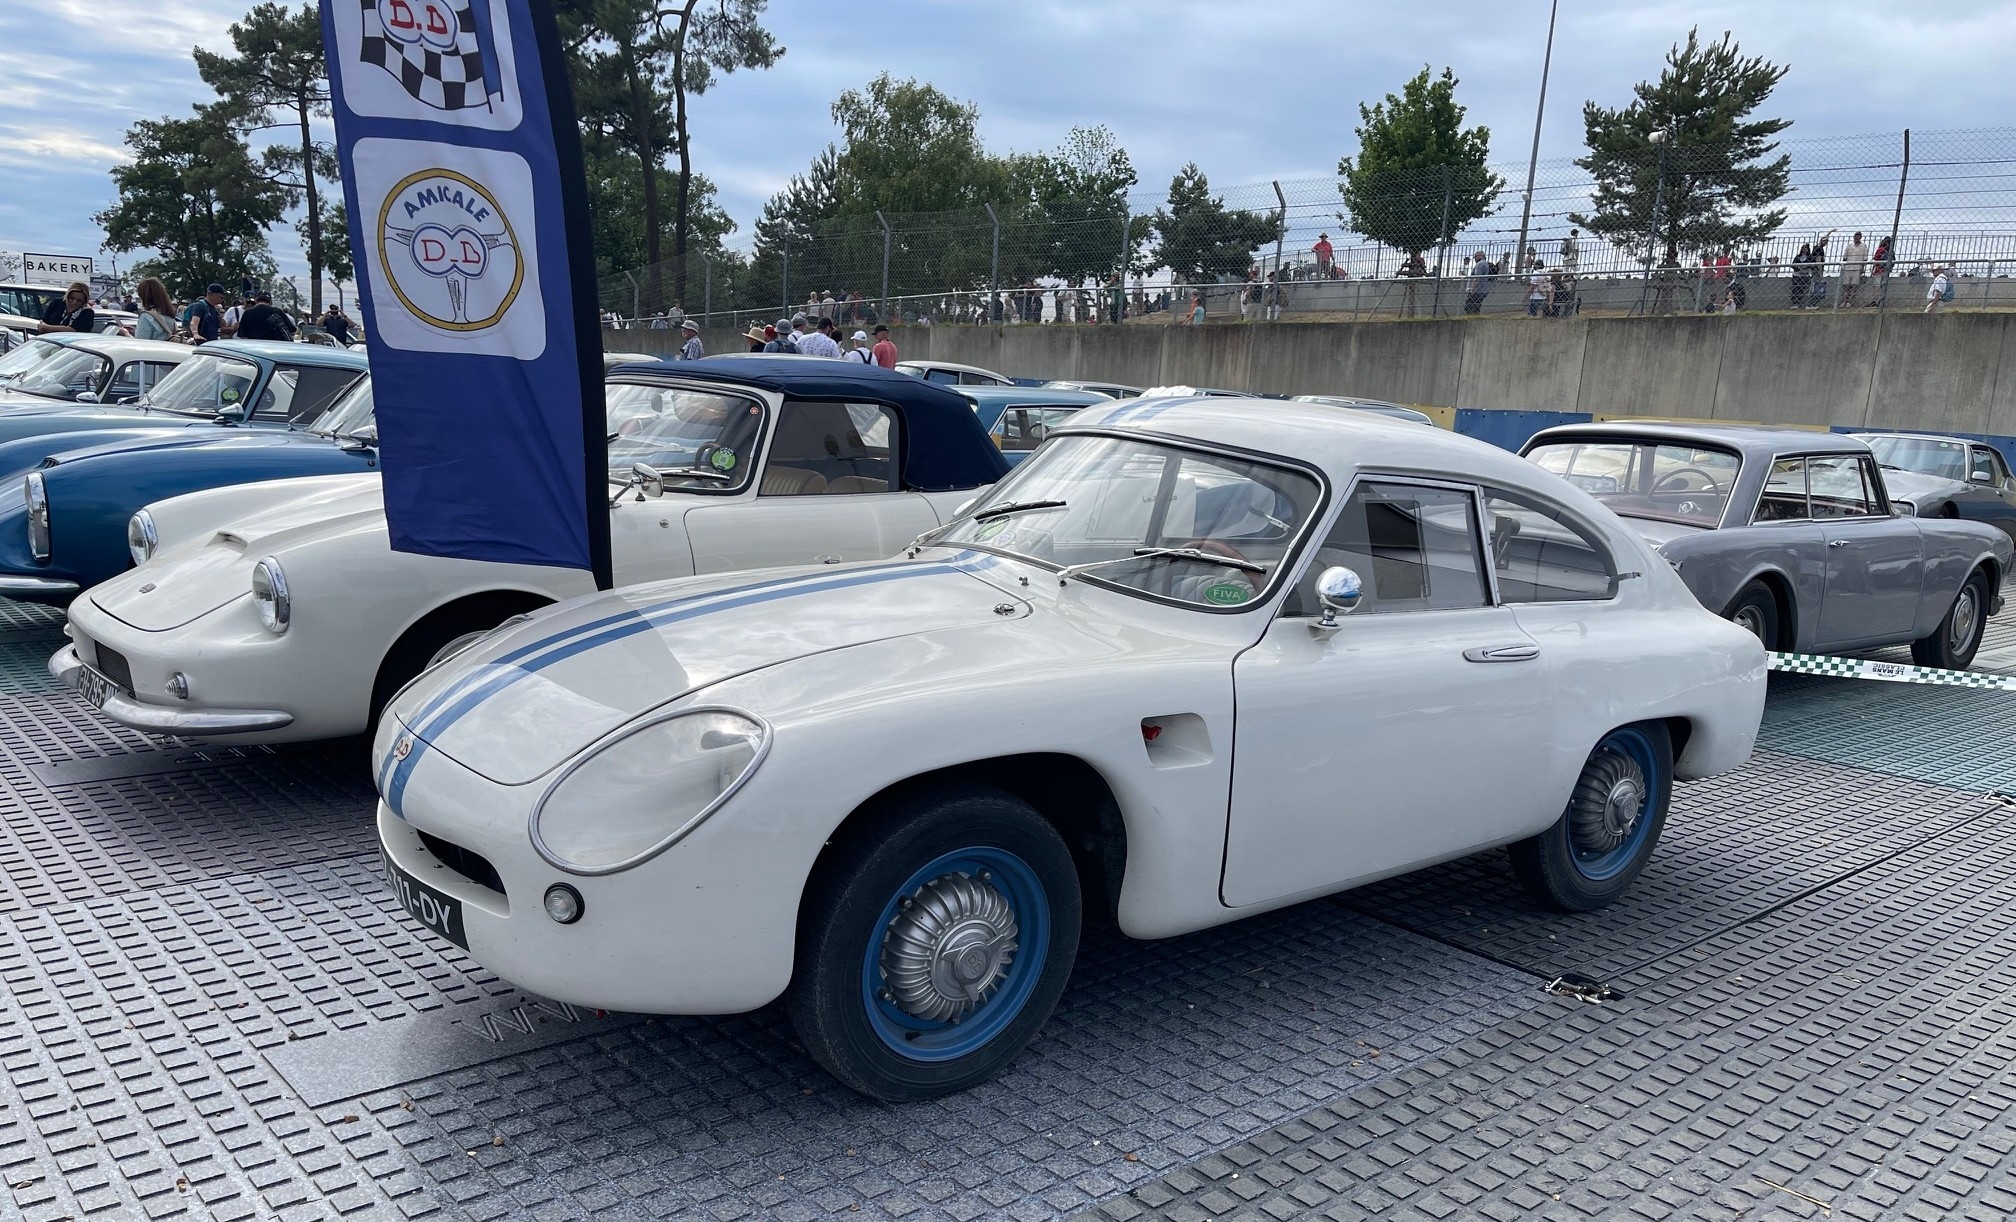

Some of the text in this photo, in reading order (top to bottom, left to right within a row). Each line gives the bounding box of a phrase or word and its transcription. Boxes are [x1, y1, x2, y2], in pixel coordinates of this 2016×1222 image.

[403, 185, 490, 223] AMICALE
[26, 261, 90, 274] BAKERY
[1213, 589, 1240, 599] FIVA
